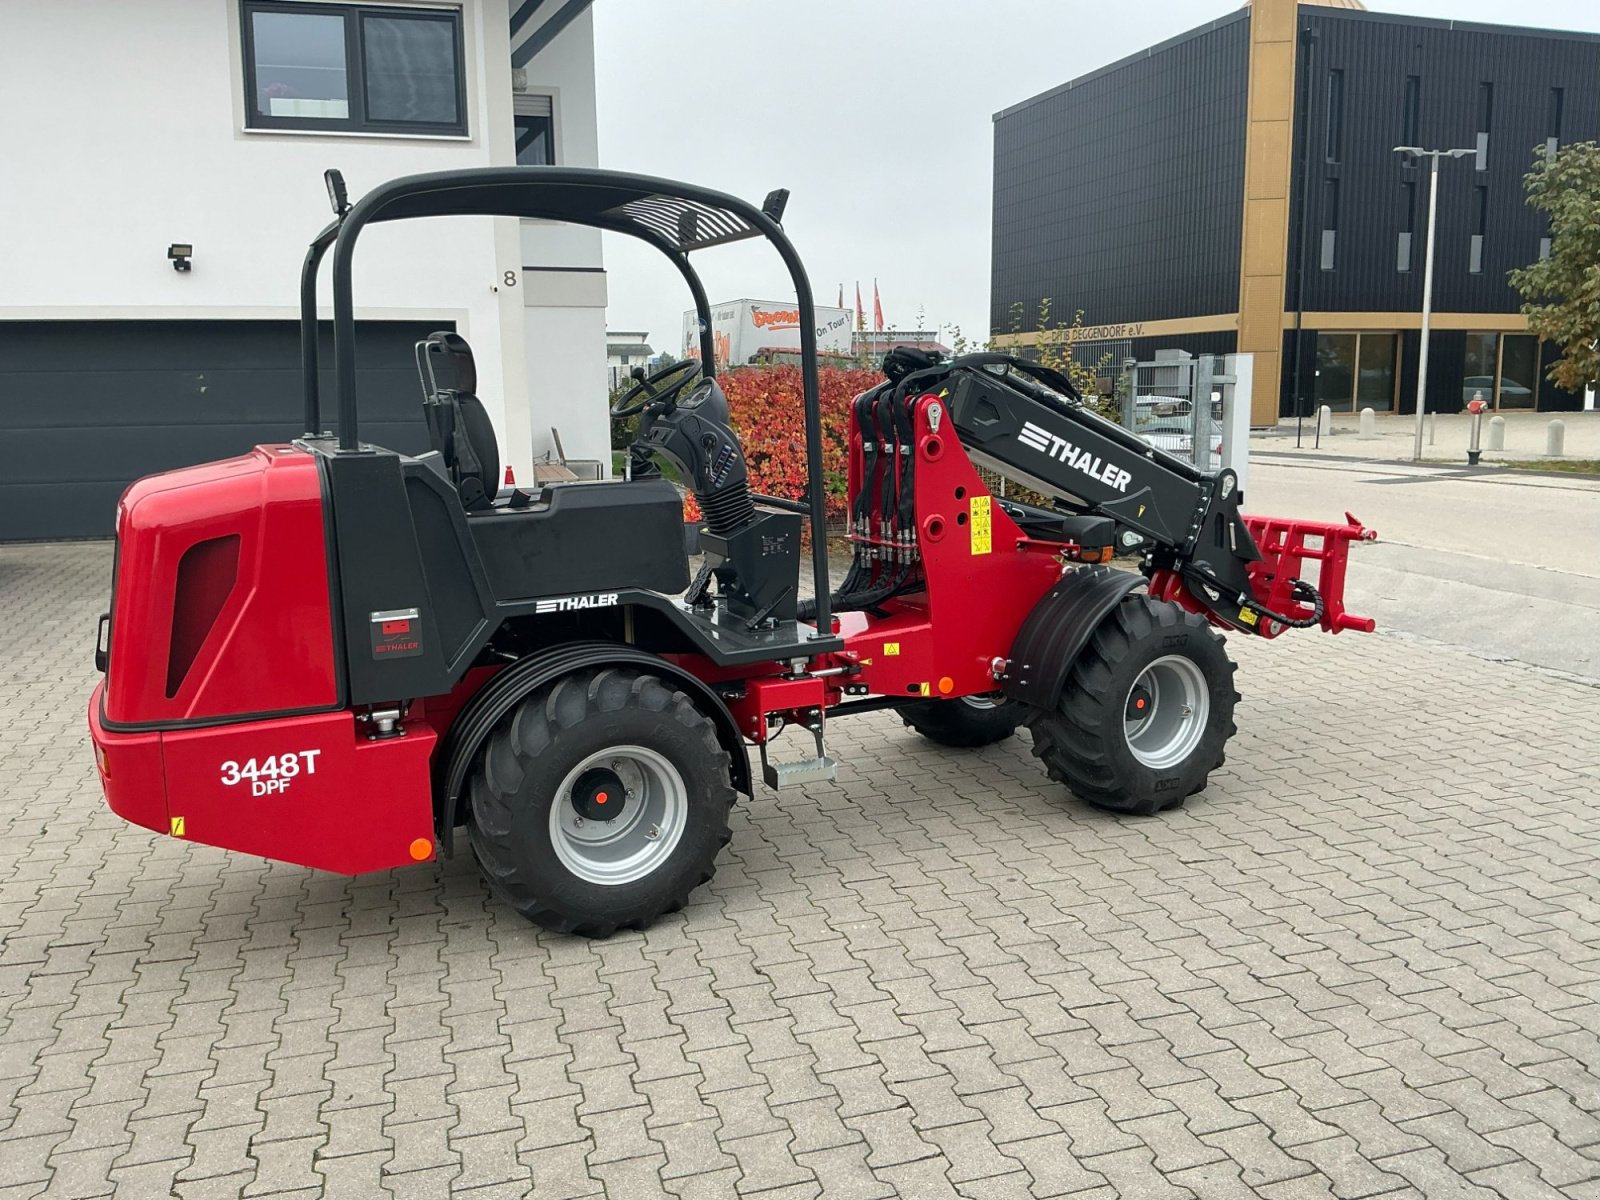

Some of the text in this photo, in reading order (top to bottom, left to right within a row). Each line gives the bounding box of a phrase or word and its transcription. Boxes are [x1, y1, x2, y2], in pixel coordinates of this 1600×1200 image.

[503, 270, 517, 287] 8
[816, 329, 828, 337] On
[827, 317, 845, 331] Tour
[1072, 324, 1127, 341] DEGGENDORF
[1128, 323, 1145, 337] e.V.
[1047, 435, 1133, 493] THALER
[556, 593, 619, 611] THALER
[386, 641, 418, 651] THALER
[220, 748, 321, 786] 3448T
[251, 777, 291, 797] DPF
